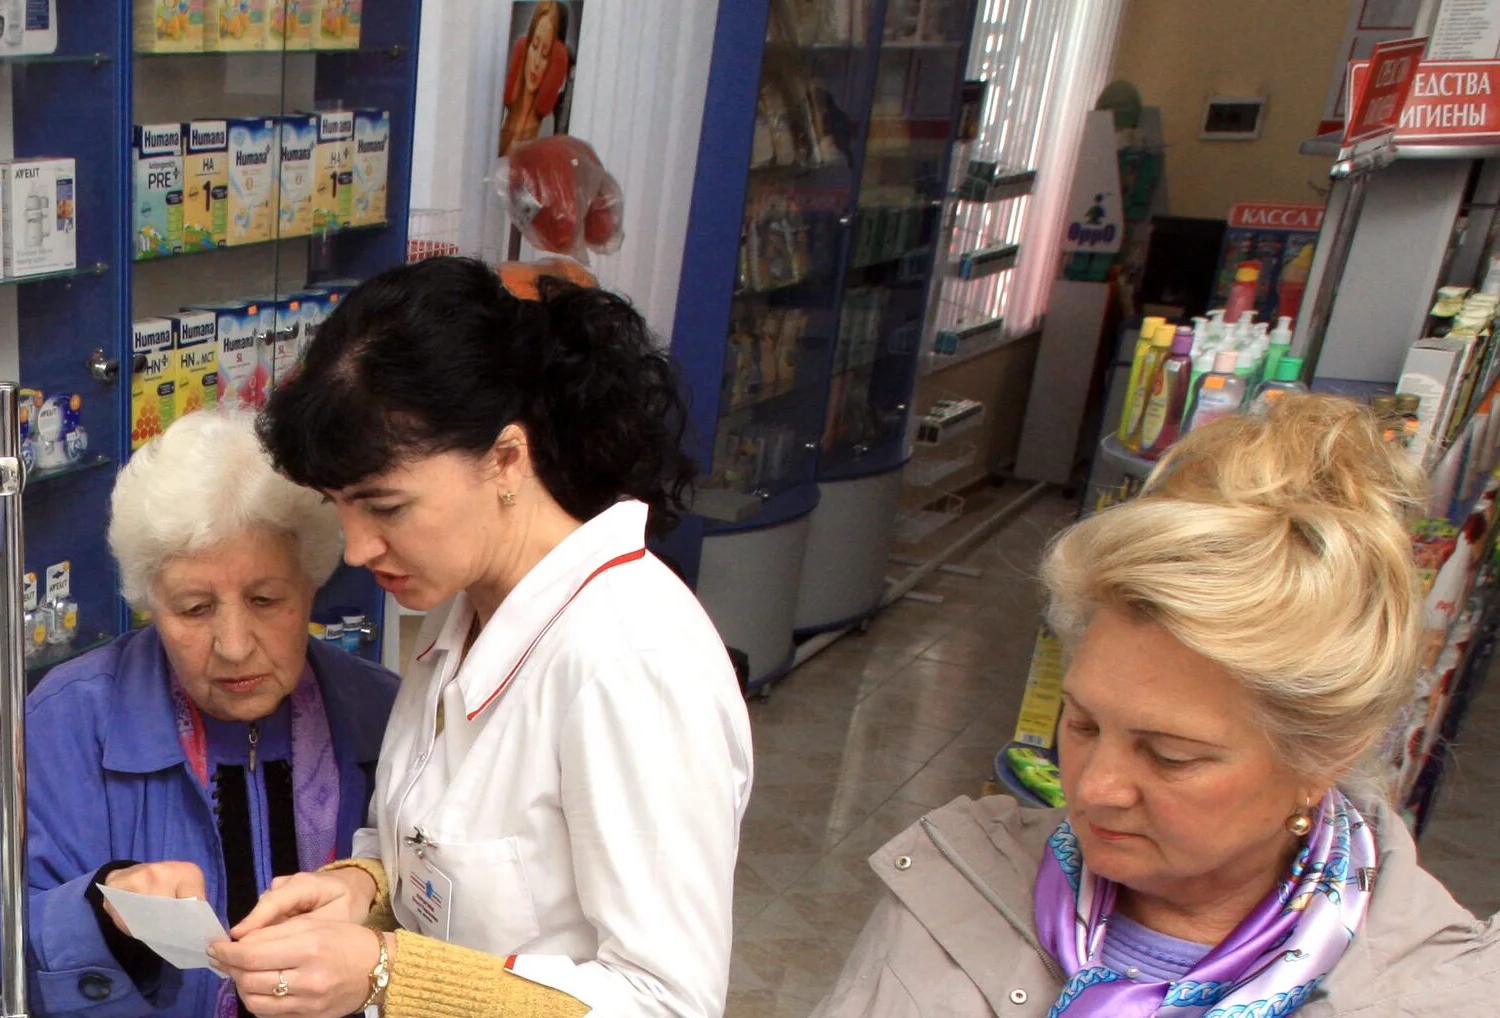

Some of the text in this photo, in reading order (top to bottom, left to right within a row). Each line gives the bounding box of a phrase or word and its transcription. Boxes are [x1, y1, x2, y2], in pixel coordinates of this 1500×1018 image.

[1414, 72, 1492, 98] ЕДСТВА
[1400, 104, 1487, 129] ИГИЕНЫ
[144, 131, 180, 147] Humana
[192, 129, 225, 145] Humana
[202, 158, 214, 172] HA
[236, 151, 267, 167] Humana
[15, 167, 41, 179] AVENT
[148, 172, 171, 189] PRE
[1242, 208, 1309, 227] КАССА
[182, 322, 214, 339] Humana
[134, 332, 171, 348] Humana
[223, 336, 254, 352] Humana
